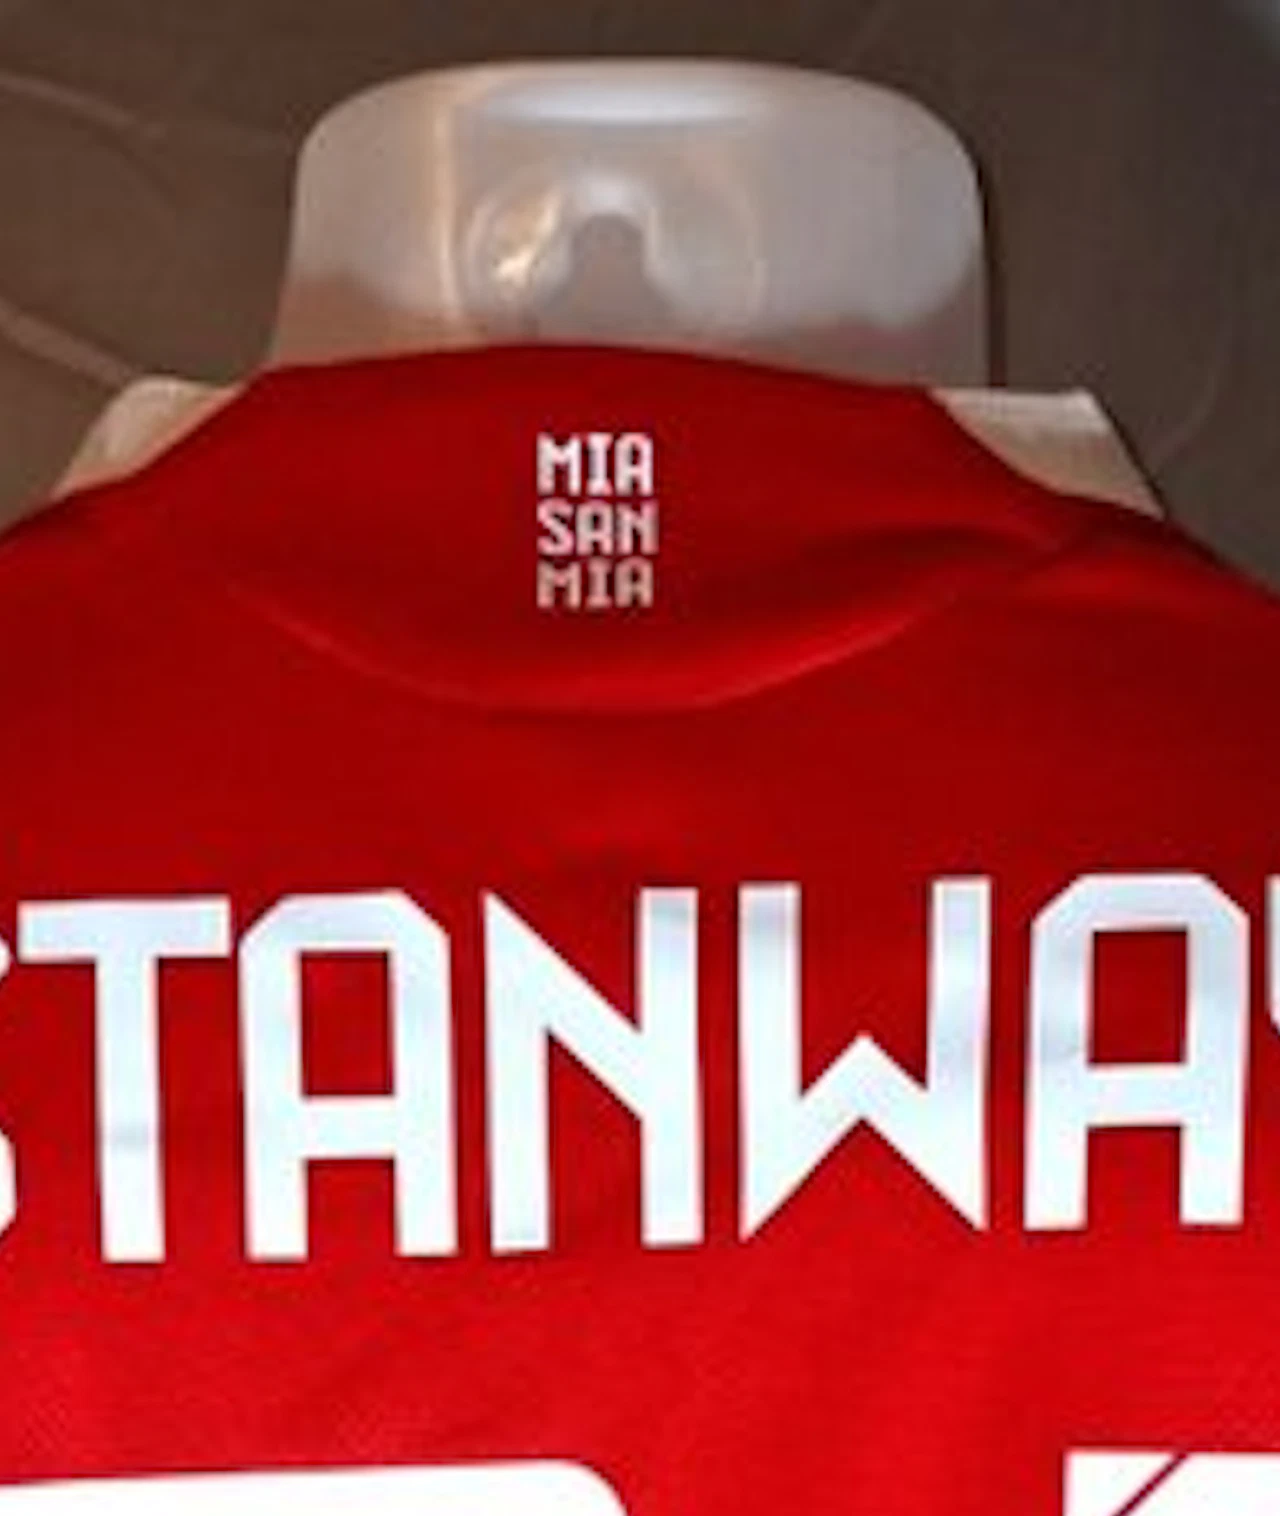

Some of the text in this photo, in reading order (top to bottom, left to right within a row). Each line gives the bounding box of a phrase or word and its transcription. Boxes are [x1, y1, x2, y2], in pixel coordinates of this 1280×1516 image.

[536, 431, 654, 497] MIA
[536, 498, 658, 556] SAN
[536, 558, 654, 609] MIA
